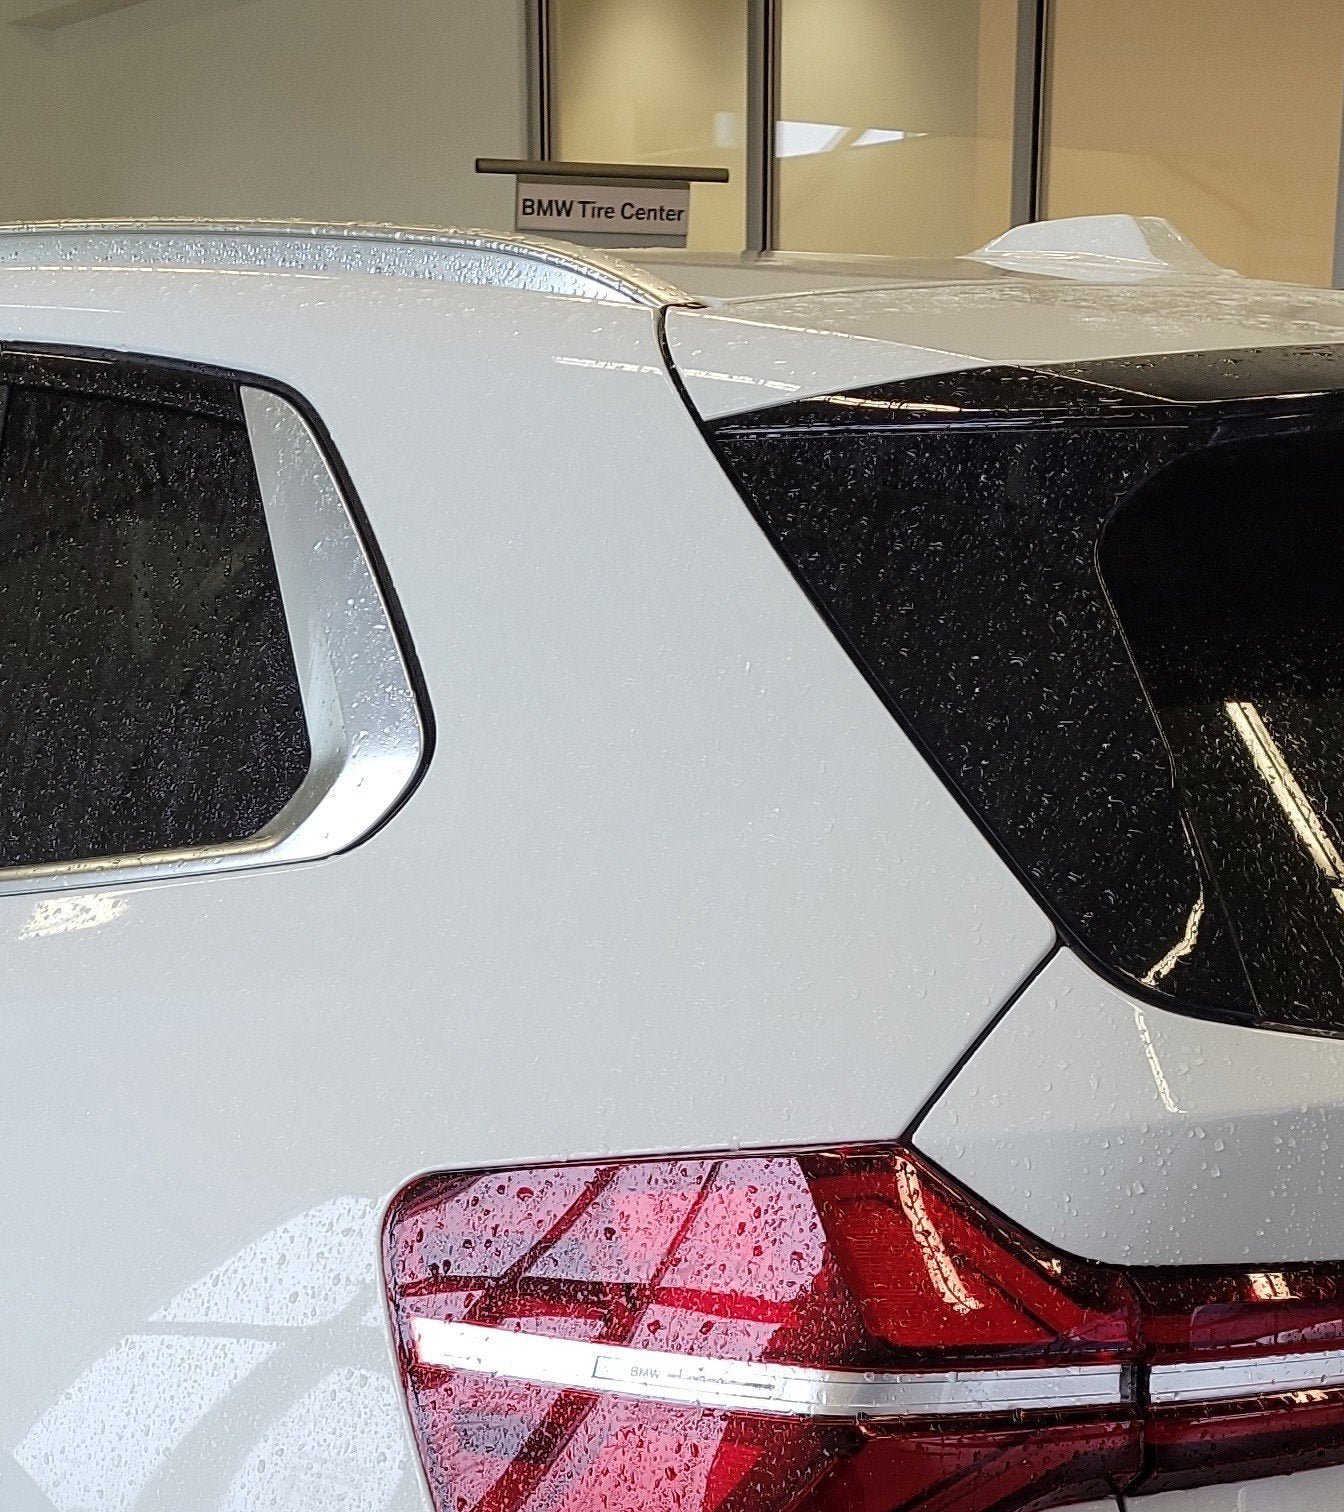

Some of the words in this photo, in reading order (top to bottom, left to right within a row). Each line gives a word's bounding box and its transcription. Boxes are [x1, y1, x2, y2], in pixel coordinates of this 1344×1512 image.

[521, 198, 573, 218] BMW
[577, 200, 616, 219] Tire
[620, 202, 686, 222] Center
